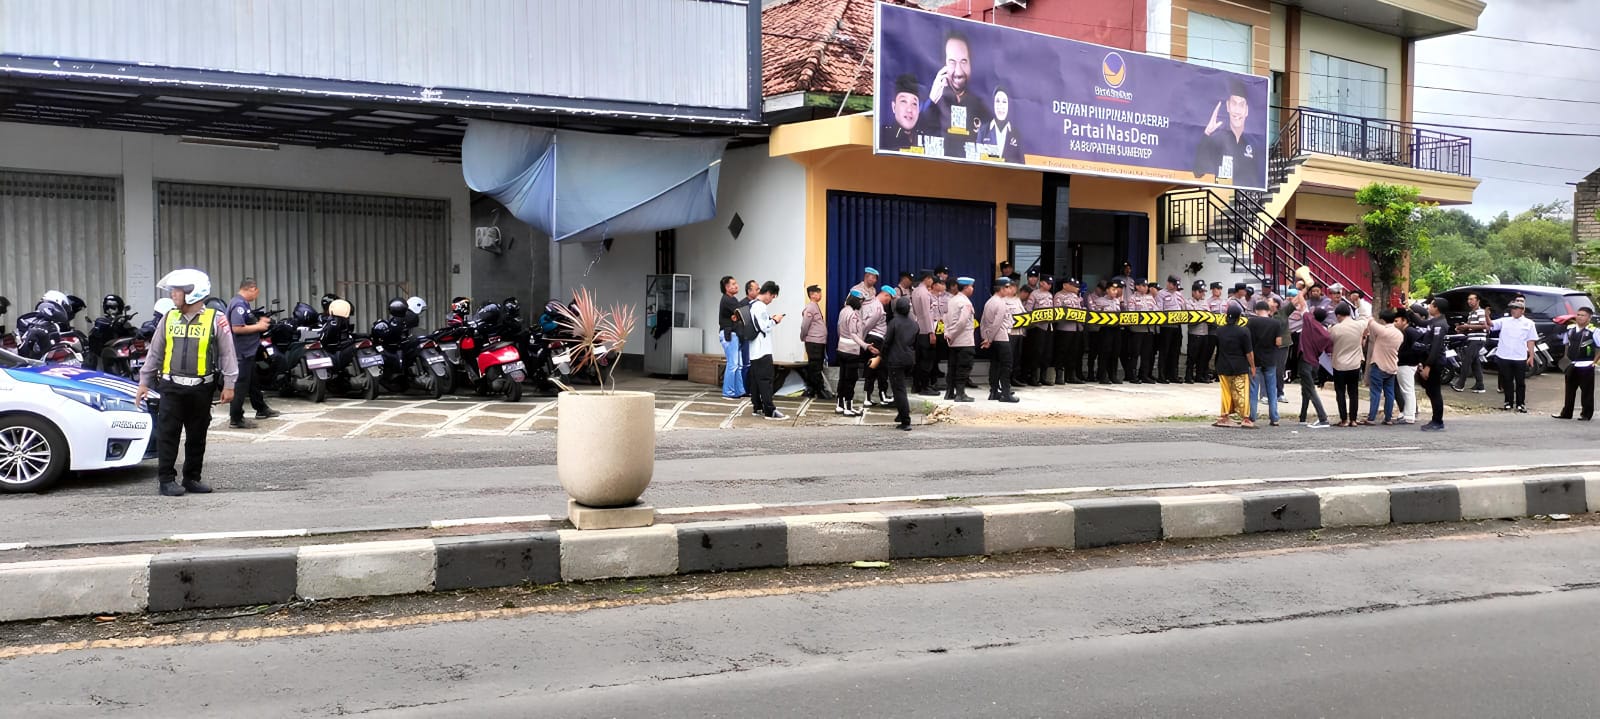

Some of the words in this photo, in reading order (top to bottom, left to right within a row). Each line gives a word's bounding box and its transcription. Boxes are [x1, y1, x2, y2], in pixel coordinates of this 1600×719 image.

[1053, 100, 1088, 117] DEWAN
[1135, 112, 1169, 128] DAERAH
[1063, 119, 1104, 139] Partai
[1106, 124, 1159, 145] NasDem
[1070, 140, 1116, 155] KABUPATEN
[168, 325, 206, 337] POLISI
